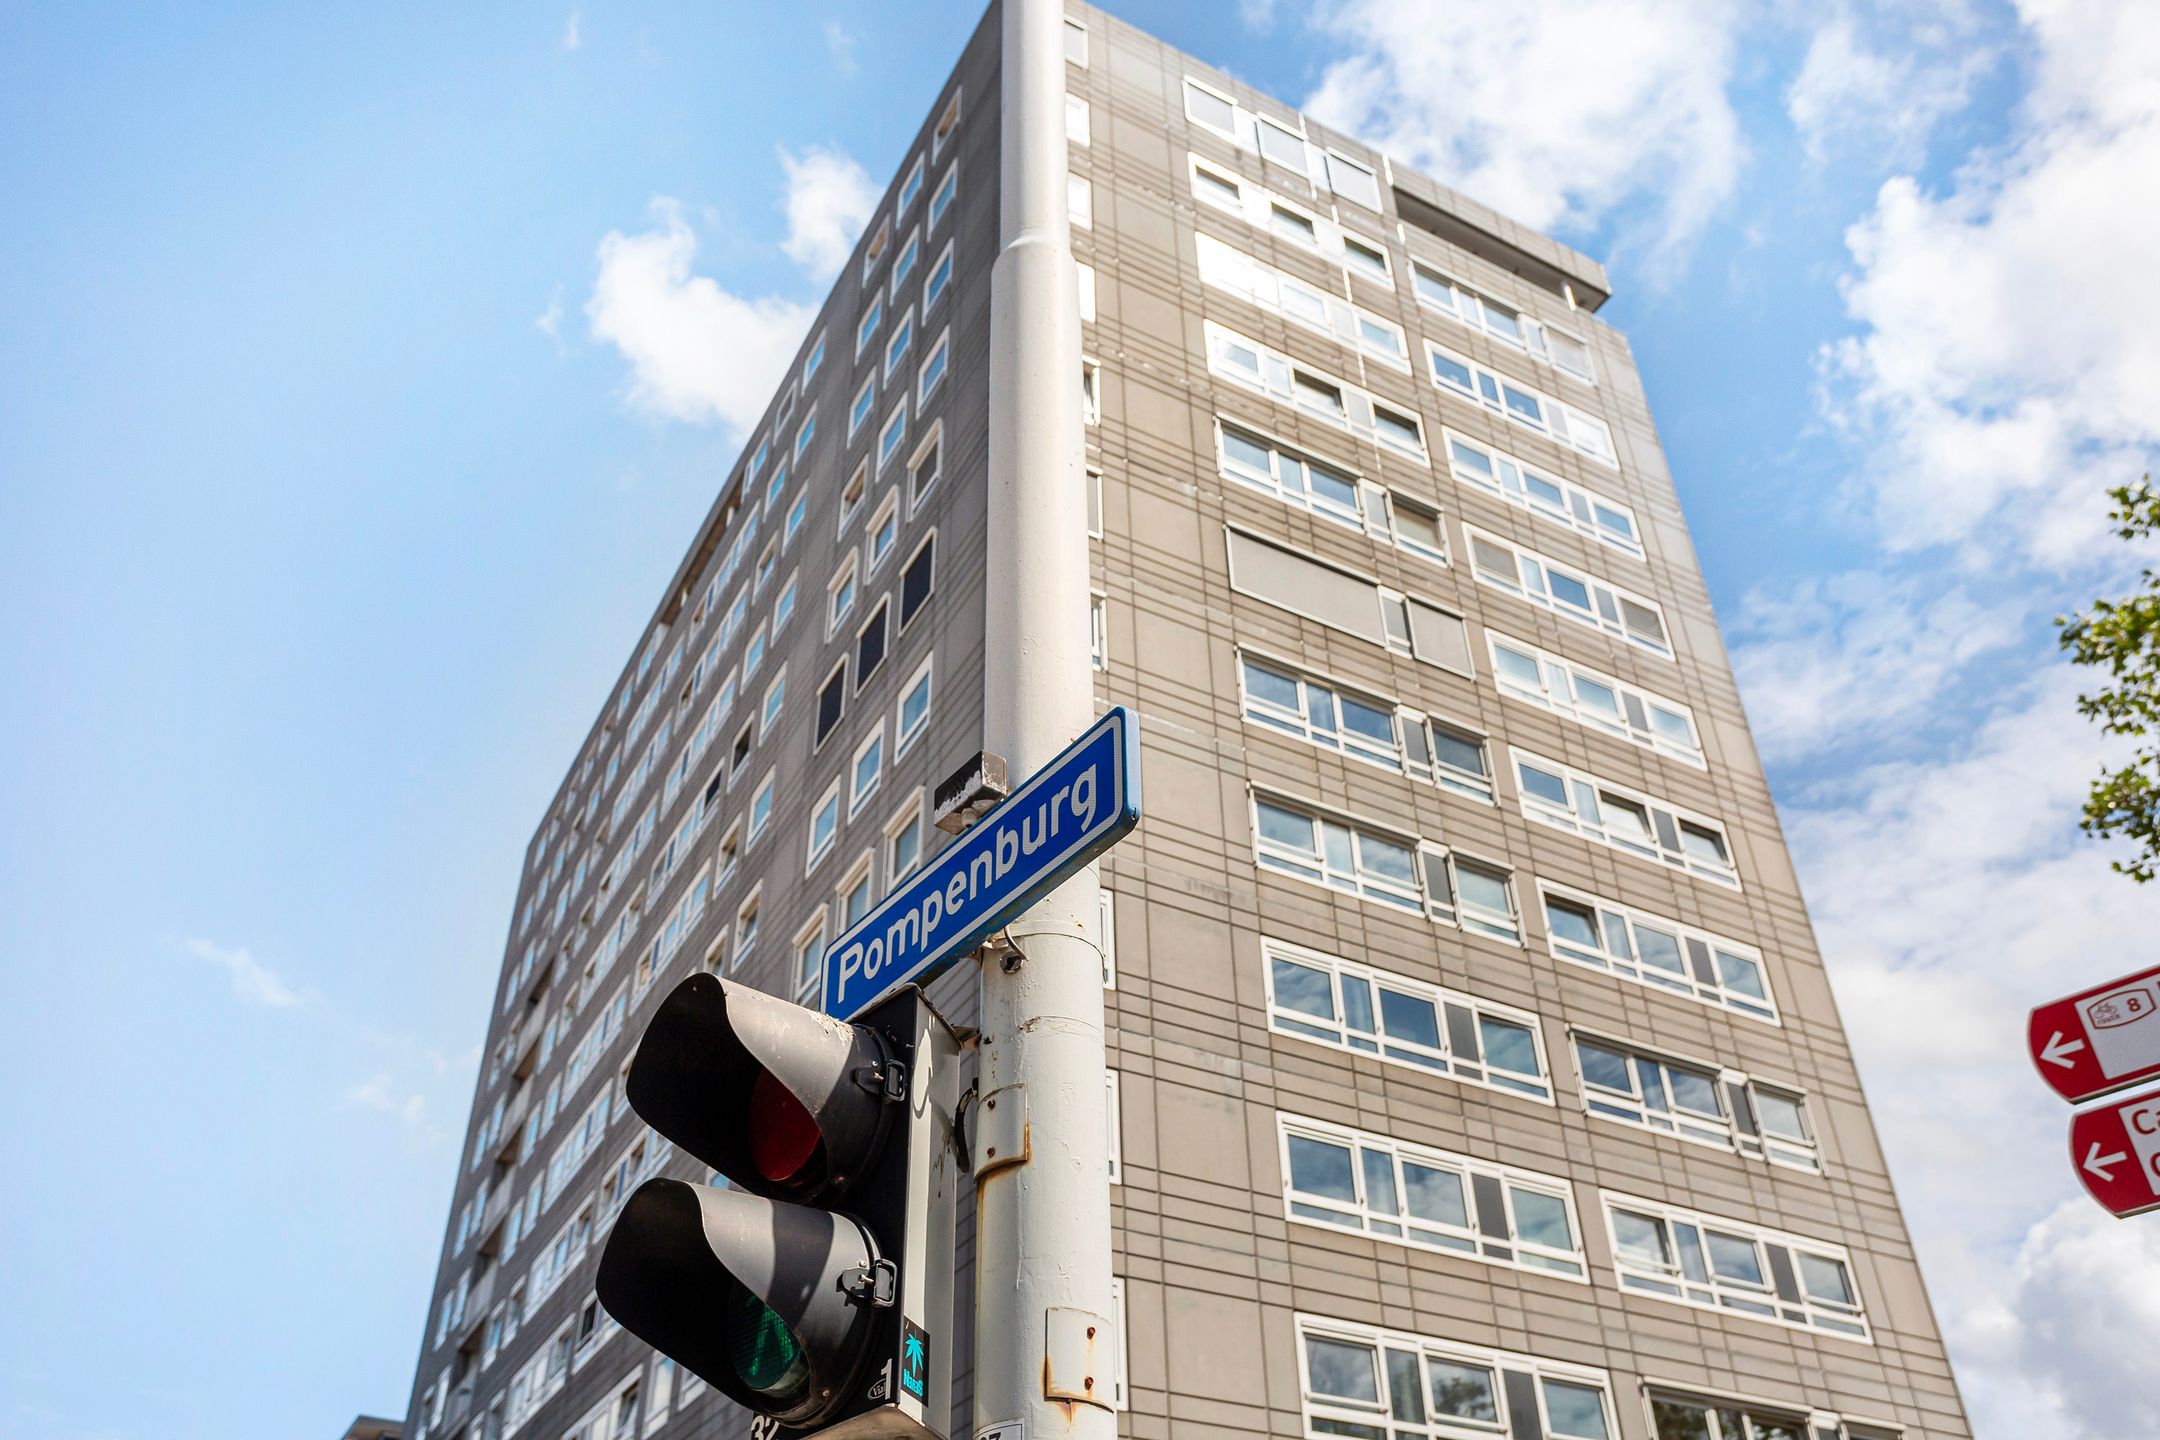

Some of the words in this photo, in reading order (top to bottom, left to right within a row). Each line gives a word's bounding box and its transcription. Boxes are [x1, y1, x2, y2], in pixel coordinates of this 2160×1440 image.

[838, 763, 1097, 1003] Pompenburg
[2127, 997, 2141, 1012] 8
[880, 1358, 892, 1400] 1
